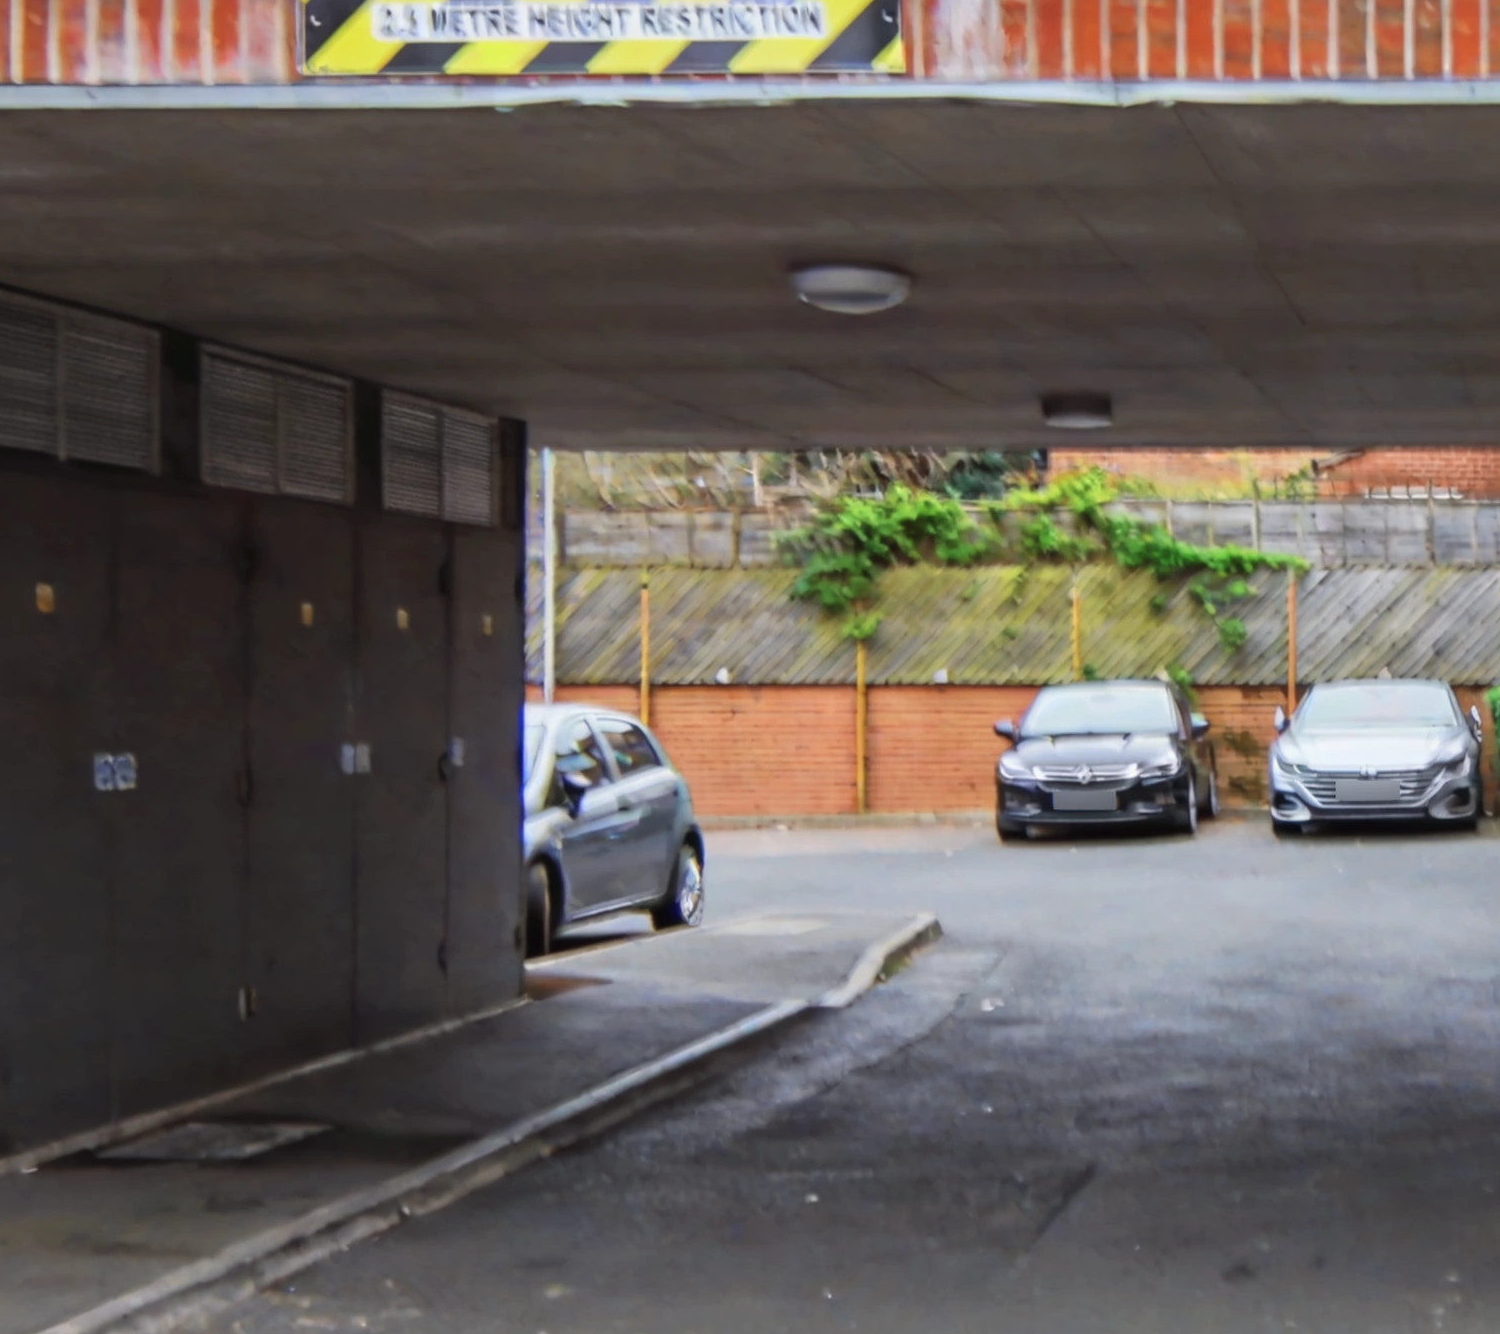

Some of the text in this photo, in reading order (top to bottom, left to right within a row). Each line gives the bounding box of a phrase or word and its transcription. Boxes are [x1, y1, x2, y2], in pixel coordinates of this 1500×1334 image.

[430, 2, 521, 36] METRE
[528, 1, 632, 36] HEIGHT
[641, 1, 823, 35] RESTRICTION
